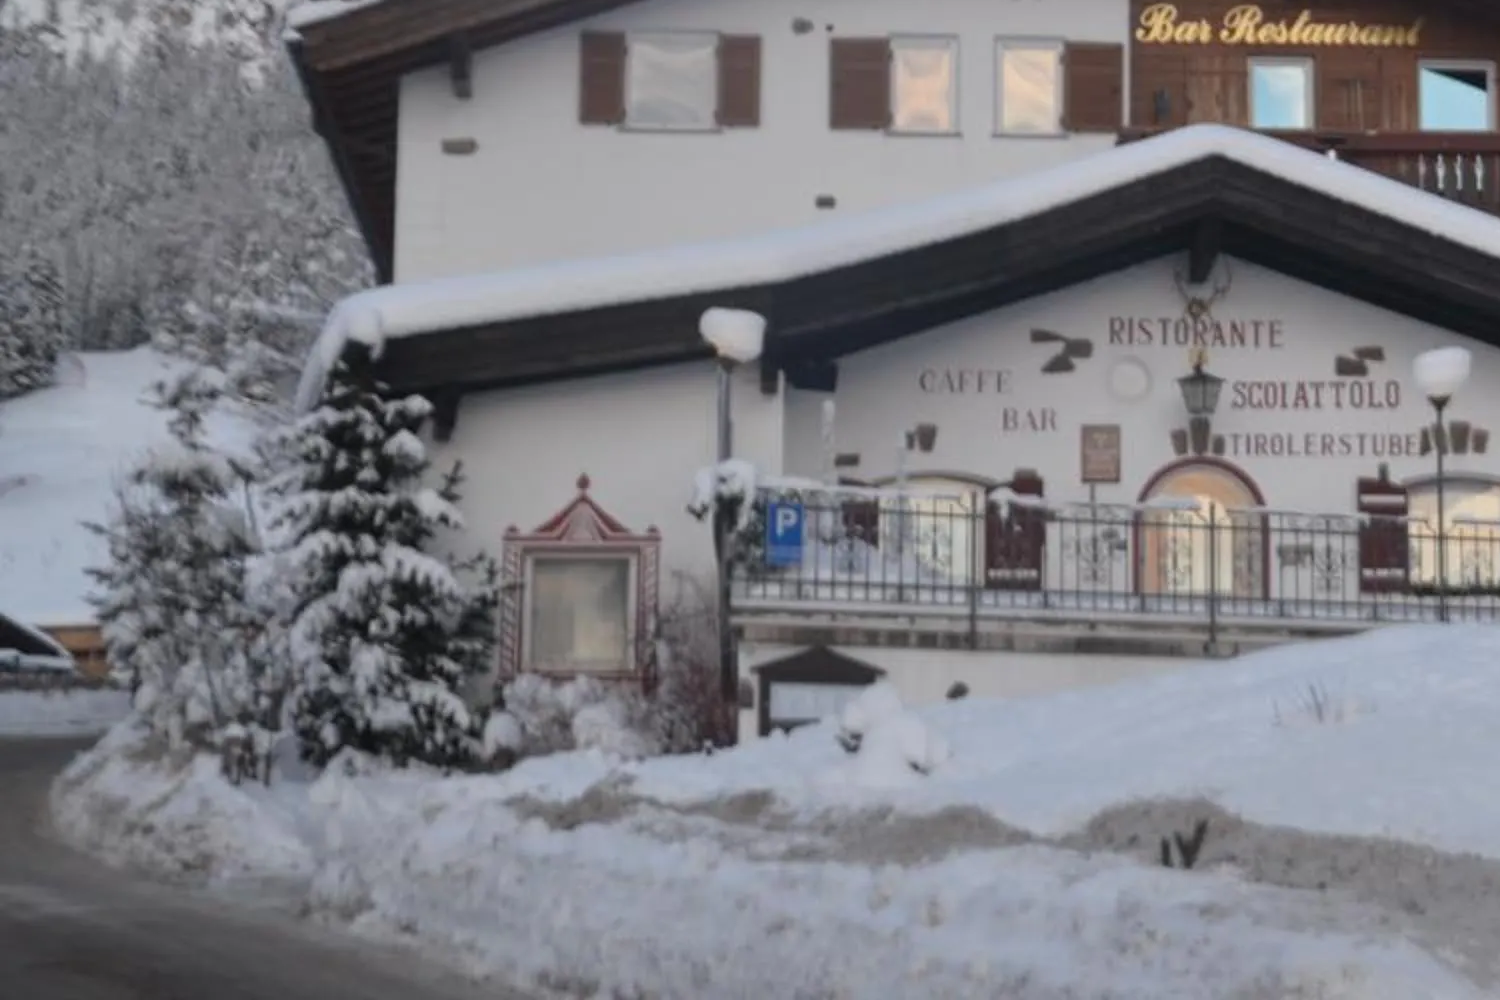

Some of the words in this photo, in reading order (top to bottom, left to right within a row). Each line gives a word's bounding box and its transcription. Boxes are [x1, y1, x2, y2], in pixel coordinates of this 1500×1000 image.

[1136, 3, 1212, 43] Bar
[1219, 3, 1423, 46] Restaurant
[1109, 316, 1284, 348] RISTORANTE
[1230, 380, 1401, 409] SCOIATTOLO
[1002, 407, 1057, 432] BAR
[1230, 433, 1419, 456] TIROLERSTUBE
[776, 508, 797, 535] P
